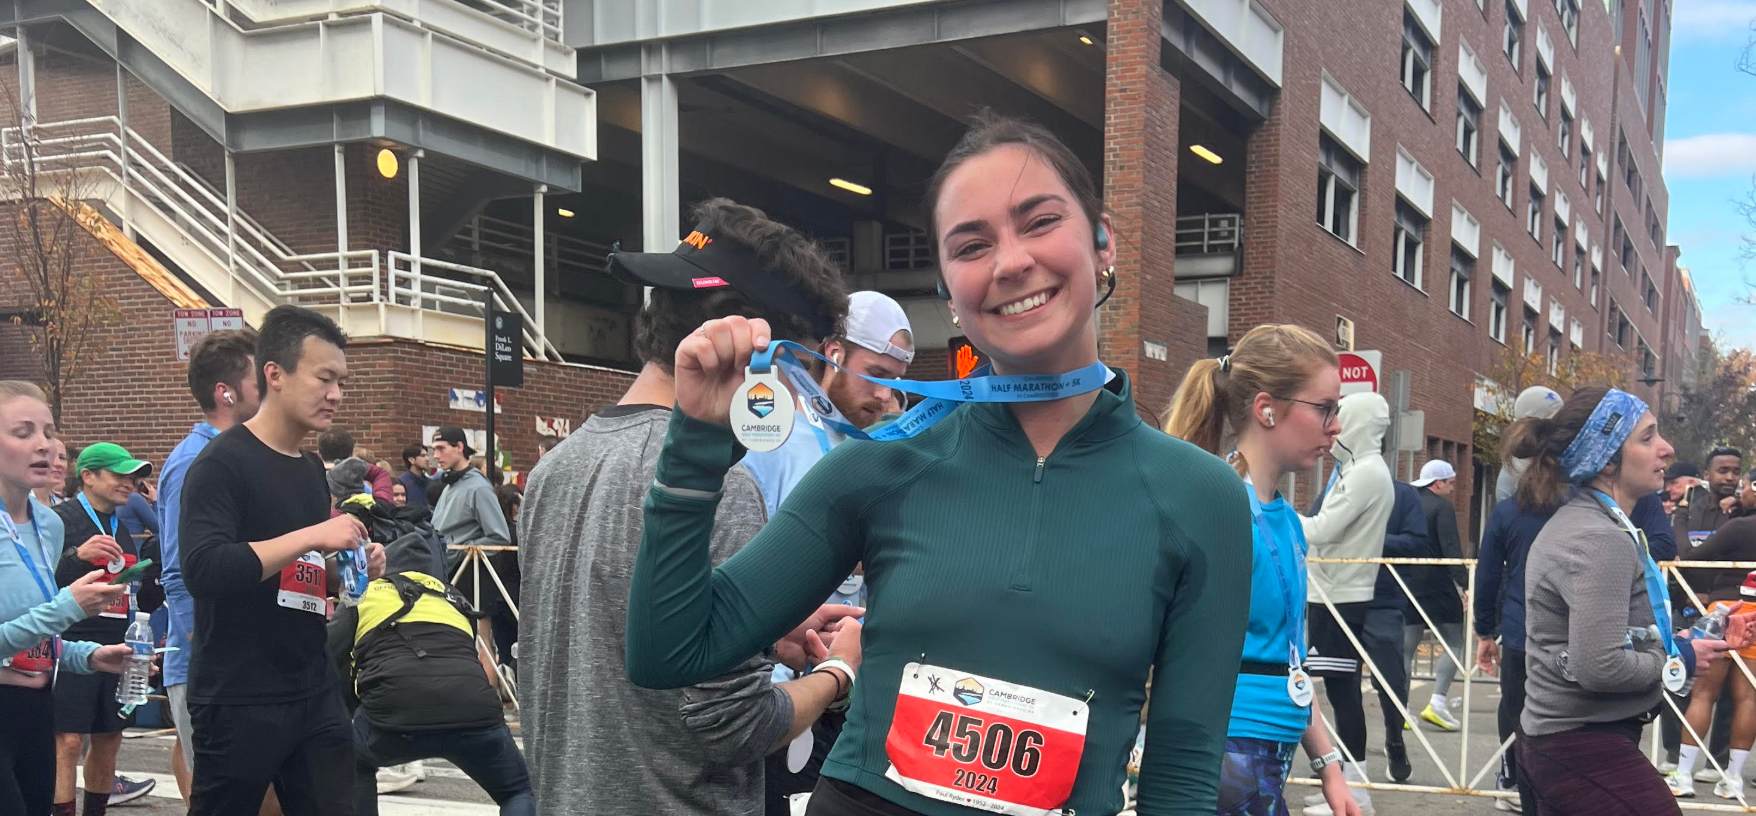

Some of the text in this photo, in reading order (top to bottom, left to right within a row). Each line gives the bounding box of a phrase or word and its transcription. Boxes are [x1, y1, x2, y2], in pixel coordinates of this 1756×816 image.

[495, 335, 507, 343] Frank
[495, 343, 512, 352] DiLeo
[495, 352, 512, 362] Square
[1342, 366, 1369, 379] NOT
[960, 379, 974, 400] 2024
[991, 383, 1011, 393] HALF
[1013, 382, 1065, 392] MARATHON
[1071, 378, 1081, 387] 5K
[927, 401, 944, 418] HALF
[741, 424, 781, 433] CAMBRIDGE
[302, 600, 317, 611] 3512
[988, 689, 1036, 705] CAMBRIDGE
[923, 710, 1044, 778] 4506
[953, 768, 999, 795] 2024
[935, 789, 948, 798] Paul
[948, 793, 965, 802] Ryder
[972, 798, 986, 807] 1952
[990, 803, 1005, 811] 2024
